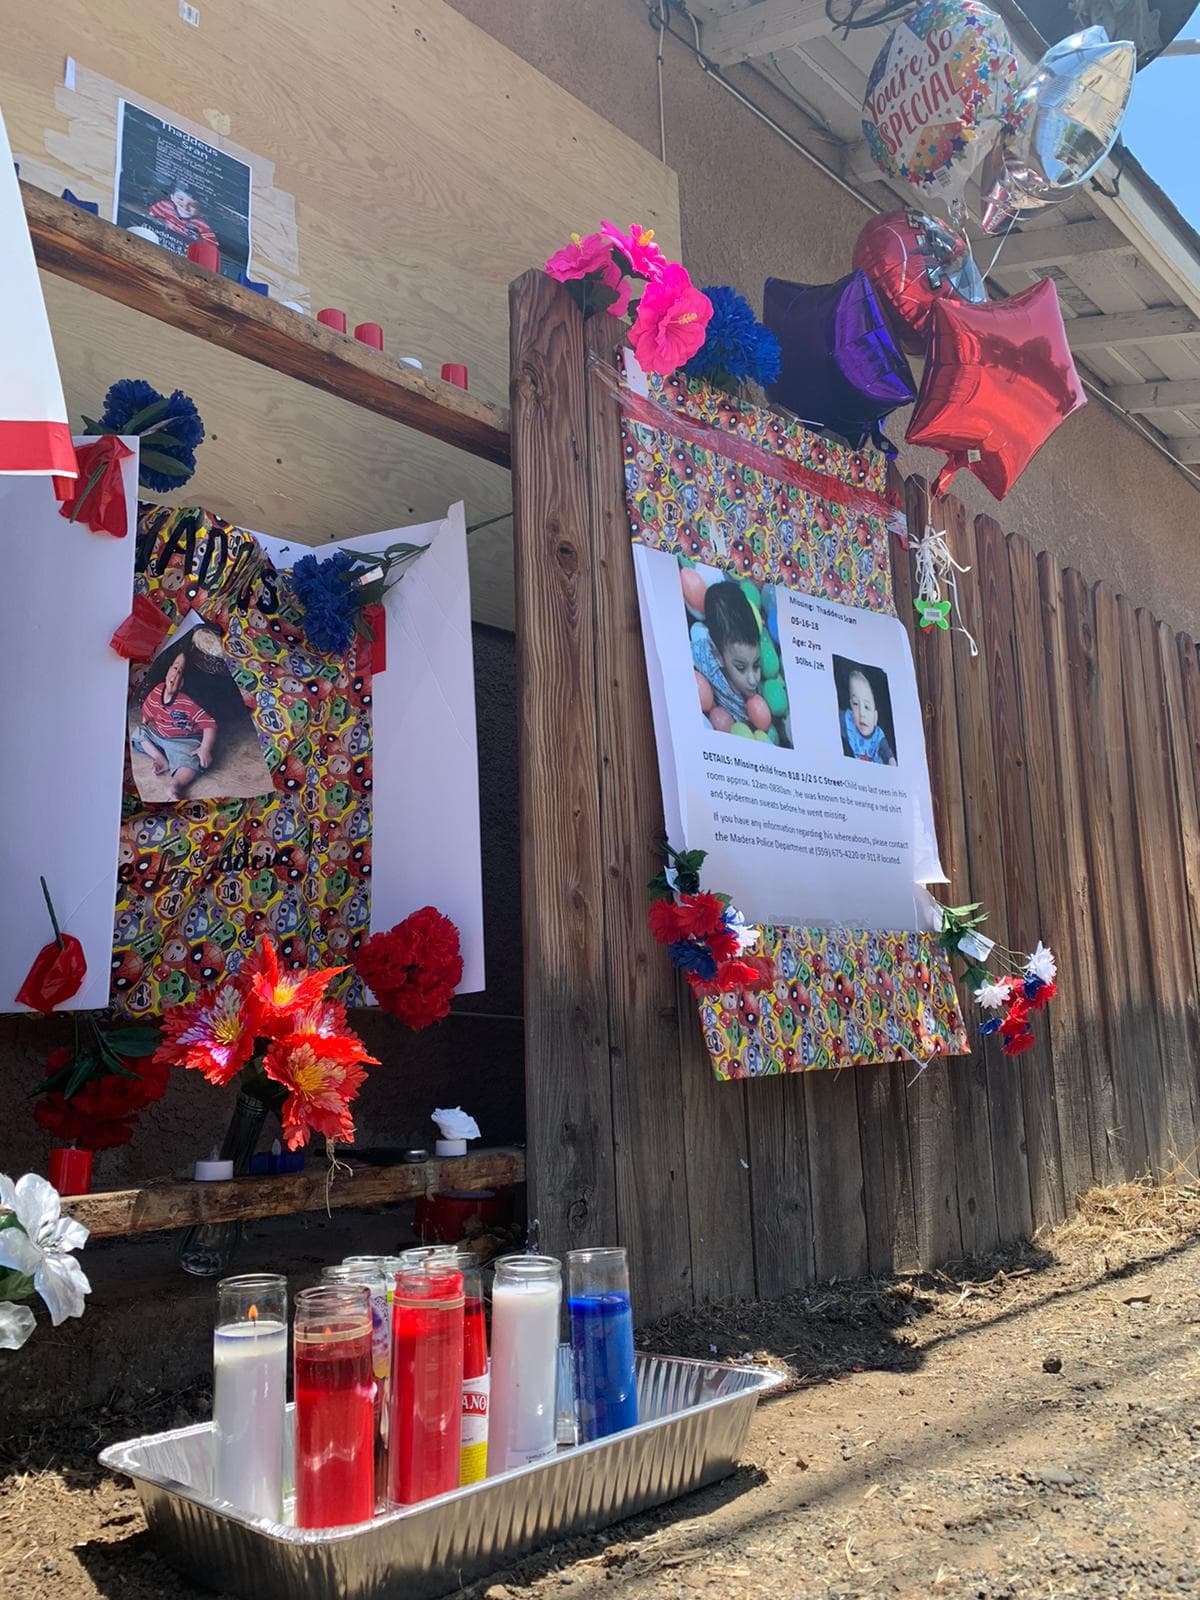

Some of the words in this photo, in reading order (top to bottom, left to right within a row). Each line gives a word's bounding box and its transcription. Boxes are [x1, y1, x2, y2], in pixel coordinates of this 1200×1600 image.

[867, 54, 922, 125] You're
[926, 28, 952, 67] So
[880, 62, 962, 155] SPECIAL
[161, 121, 218, 157] Thaddeus
[181, 140, 208, 160] Sran
[789, 596, 814, 612] Missing:
[816, 605, 843, 621] Thaddeus
[790, 616, 819, 631] 05-16-18
[792, 636, 806, 648] Age:
[807, 640, 822, 652] 2yrs
[703, 751, 733, 765] DETAILS:
[734, 757, 759, 773] Missing
[758, 763, 773, 775] child
[773, 767, 787, 778] from
[787, 770, 800, 781] 818
[801, 773, 813, 784] 1/2
[857, 784, 868, 793] was
[867, 784, 878, 794] last
[878, 788, 892, 798] seen
[898, 789, 908, 799] his
[706, 771, 725, 781] room
[726, 776, 750, 787] approx.
[751, 779, 792, 796] 12am-0830am
[795, 789, 803, 799] he
[804, 792, 817, 801] was
[816, 792, 840, 804] known
[854, 799, 875, 812] wearing
[879, 803, 889, 813] red
[889, 804, 902, 815] shirt
[710, 789, 724, 800] and
[723, 790, 759, 806] Spiderman
[759, 799, 780, 810] sweats
[779, 801, 798, 814] before
[806, 808, 823, 819] went
[714, 831, 729, 842] the
[729, 833, 756, 846] Madera
[756, 836, 774, 849] Police
[774, 839, 808, 854] Department
[815, 845, 832, 858] (559)
[831, 848, 860, 860] 675-4220
[720, 815, 734, 825] you
[733, 814, 750, 826] have
[750, 820, 762, 830] any
[762, 821, 796, 835] information
[795, 827, 823, 841] regarding
[823, 830, 834, 840] his
[833, 834, 872, 846] whereabouts,
[871, 838, 889, 849] please
[888, 839, 909, 850] contact
